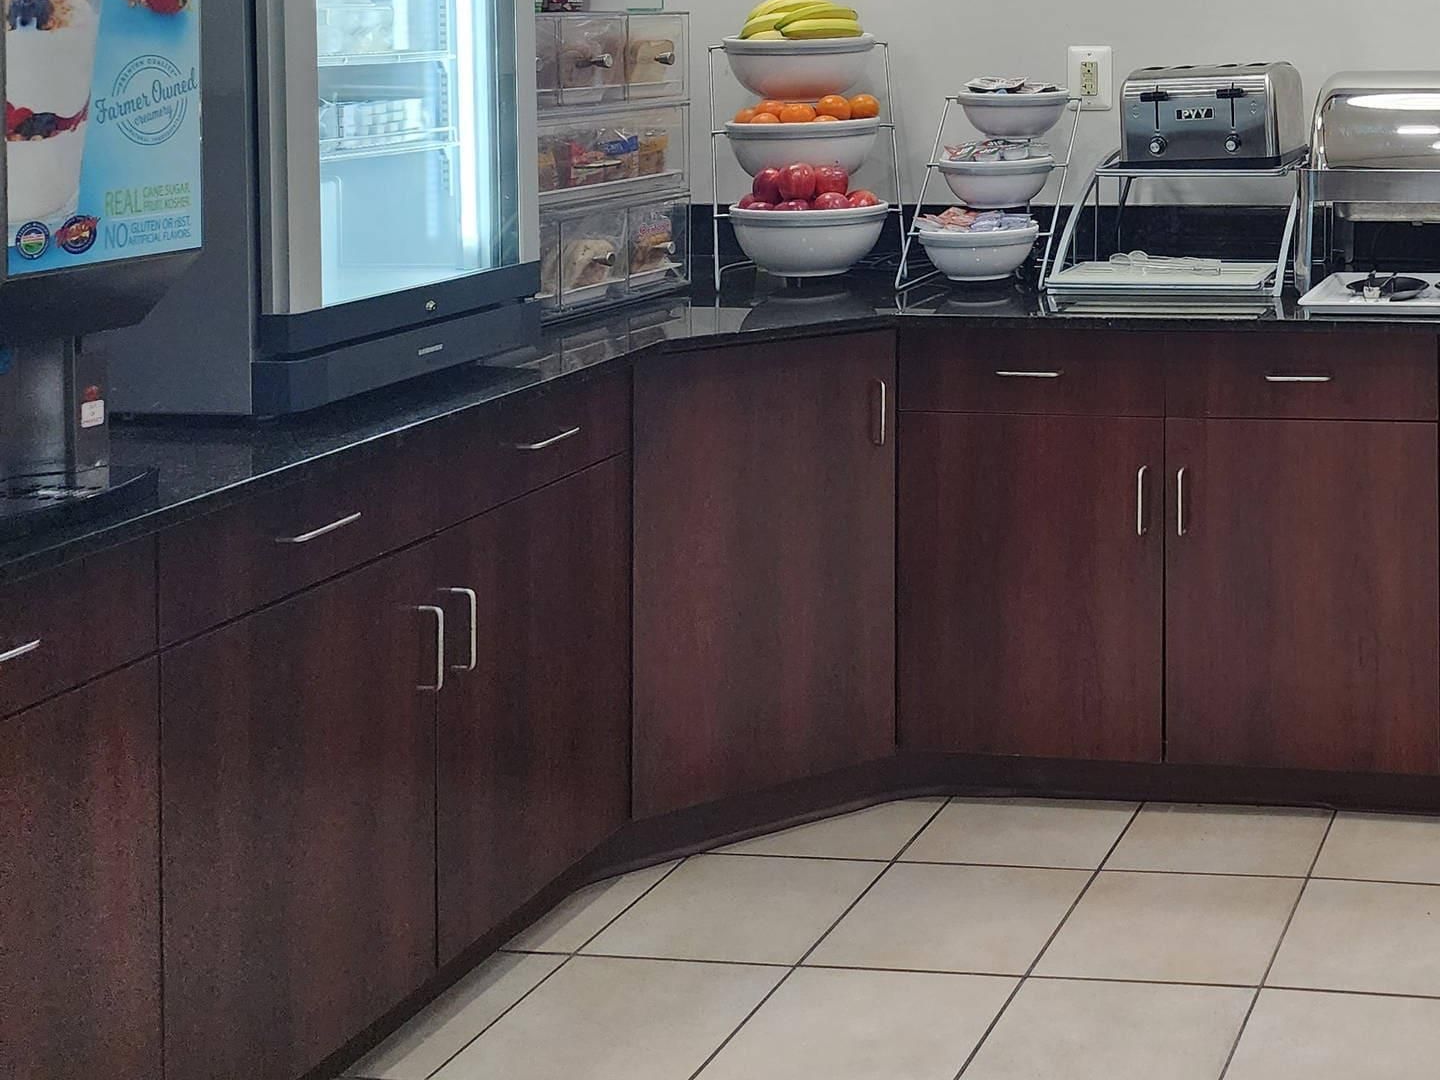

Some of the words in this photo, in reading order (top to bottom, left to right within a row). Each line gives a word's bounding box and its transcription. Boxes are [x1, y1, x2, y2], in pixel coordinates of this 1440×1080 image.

[95, 93, 150, 124] Farmer
[152, 67, 198, 103] Owned
[105, 188, 142, 217] REAL
[105, 222, 128, 249] NO
[130, 220, 160, 234] GLUTEN
